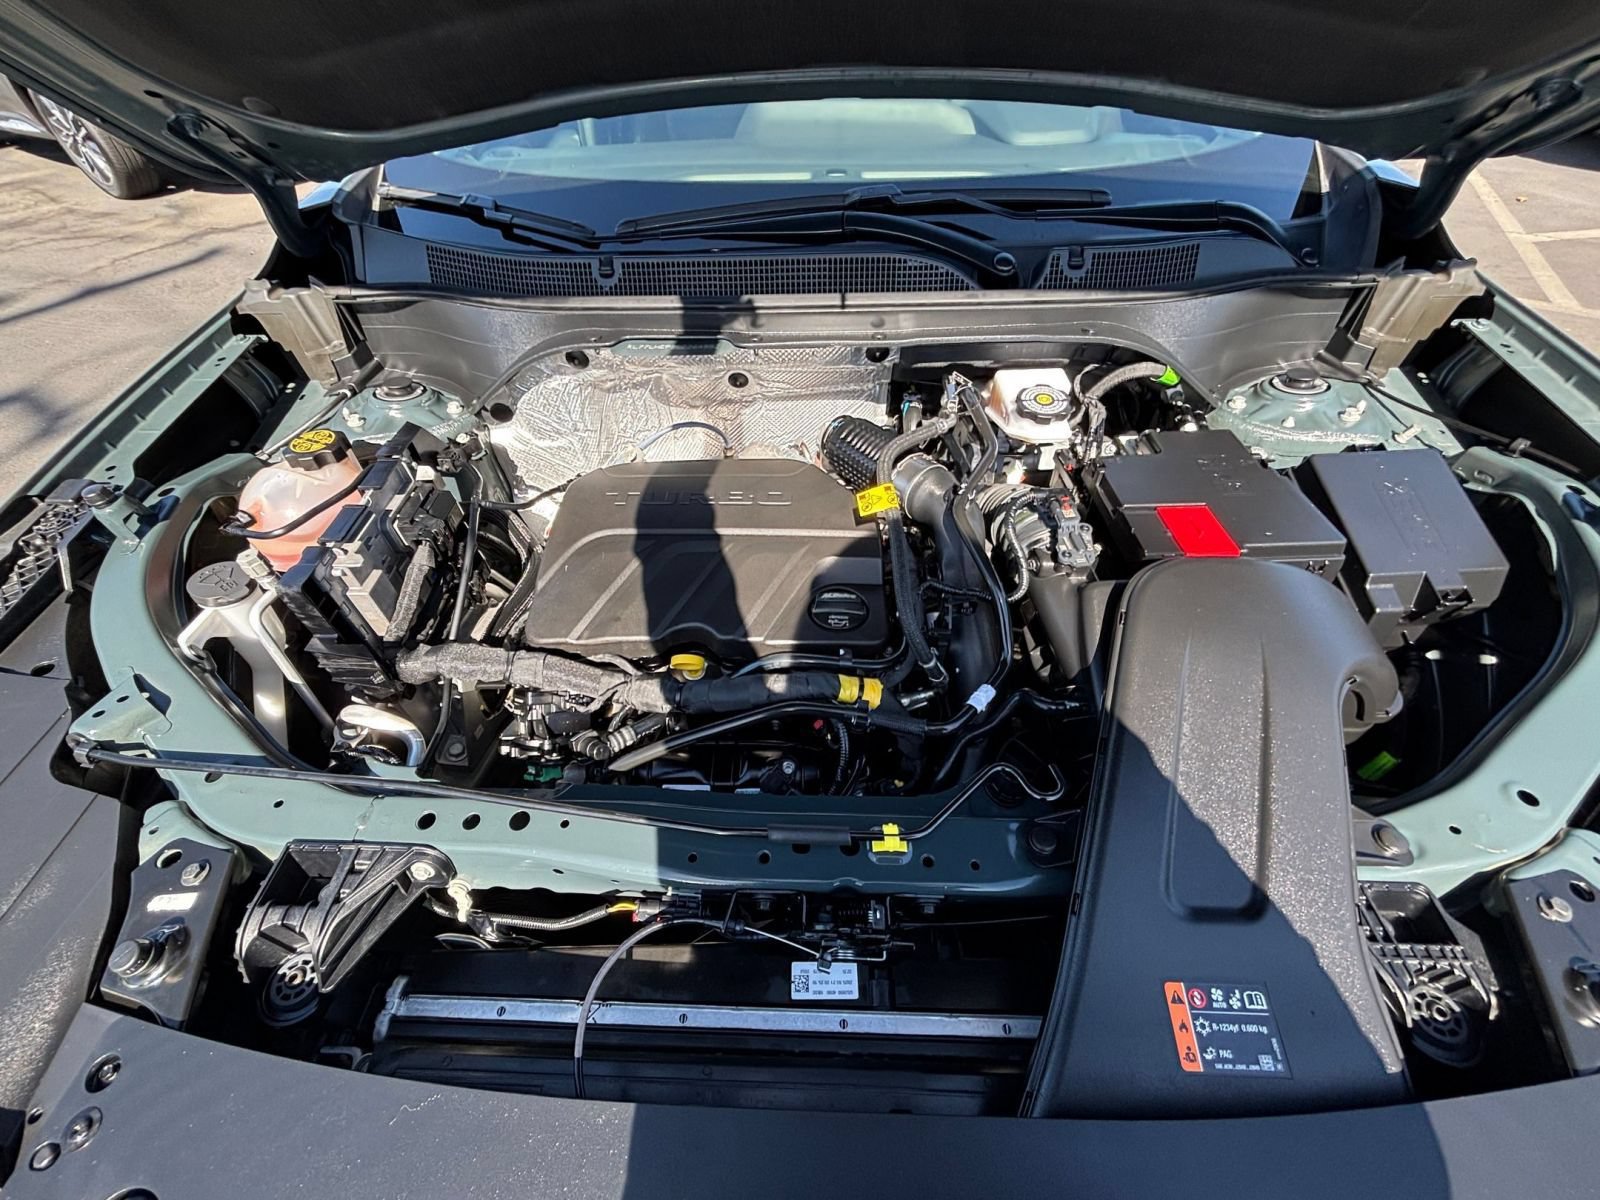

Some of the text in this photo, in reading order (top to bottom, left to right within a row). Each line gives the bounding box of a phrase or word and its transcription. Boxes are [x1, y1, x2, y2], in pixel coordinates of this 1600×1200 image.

[605, 491, 792, 505] TURBO
[1259, 1025, 1268, 1034] kg
[1219, 1050, 1233, 1058] PAG
